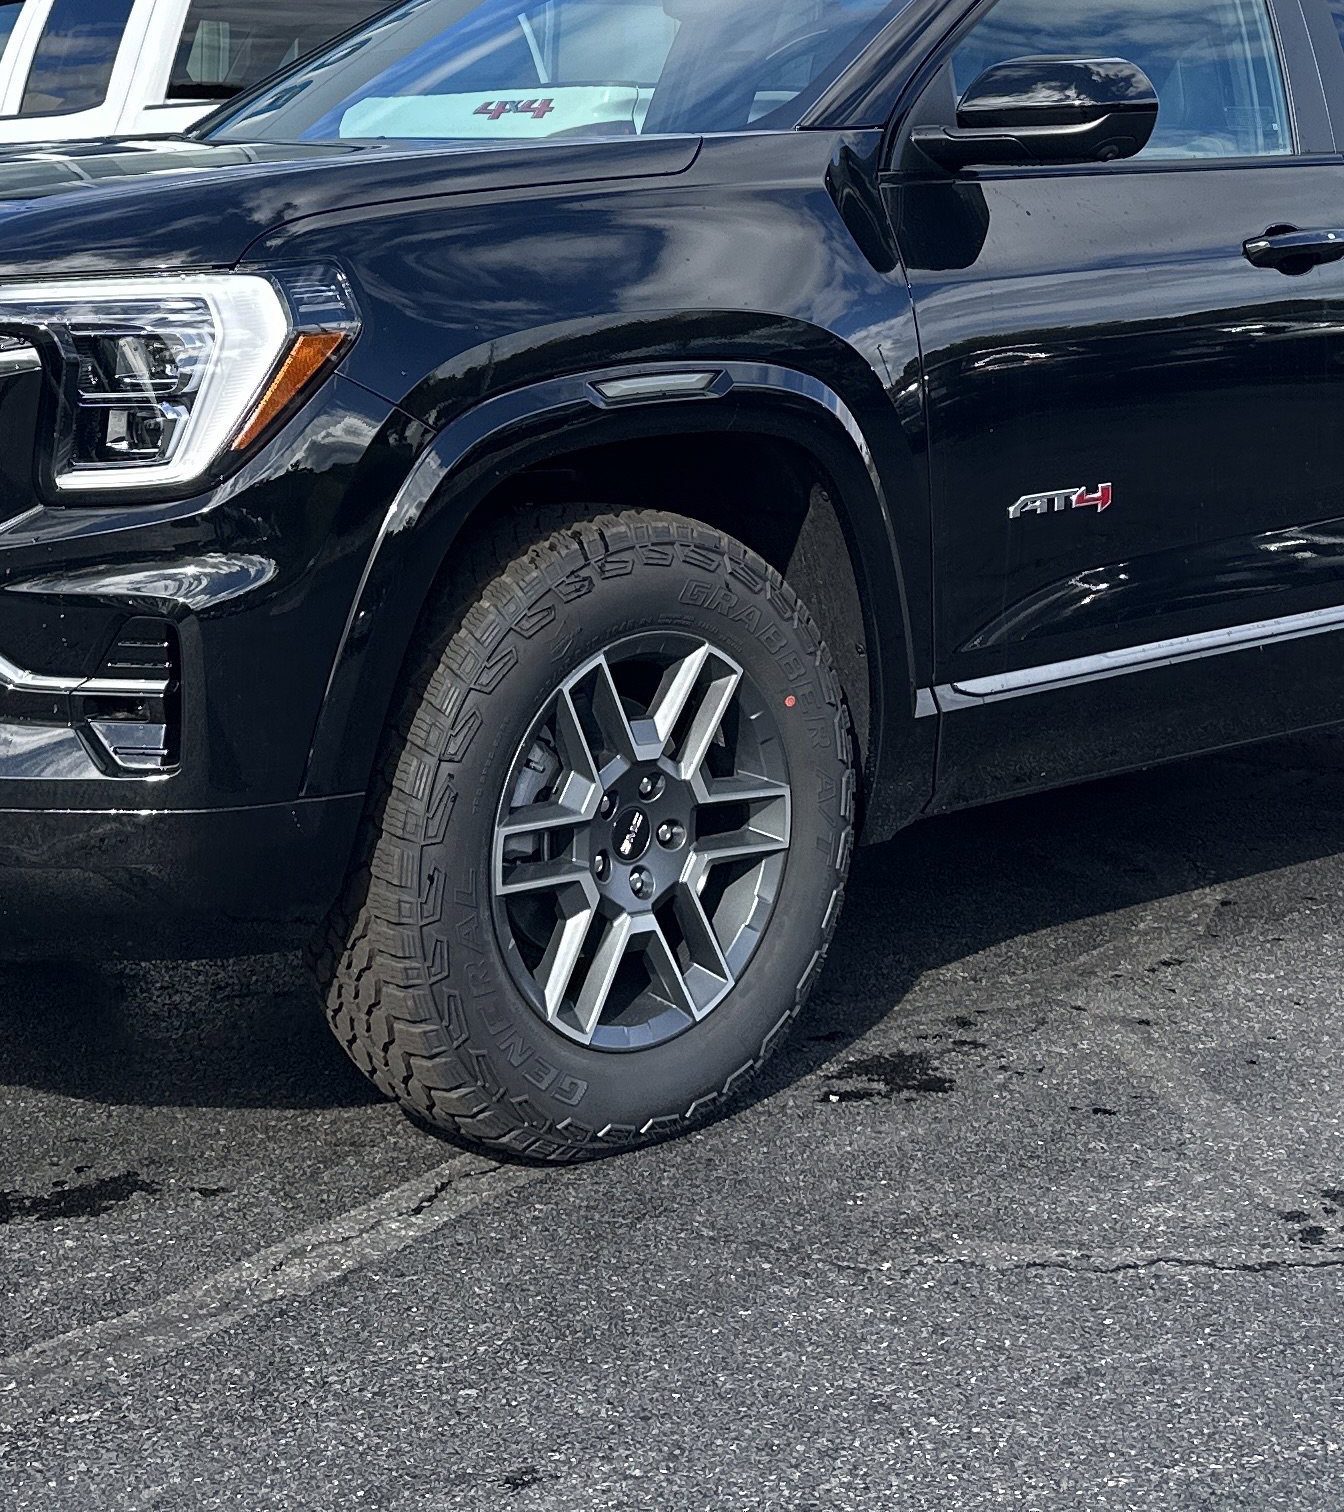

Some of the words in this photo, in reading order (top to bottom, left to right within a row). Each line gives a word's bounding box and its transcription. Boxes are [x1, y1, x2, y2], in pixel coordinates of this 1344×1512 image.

[1006, 482, 1112, 519] AT4
[678, 579, 832, 751] GRABBER
[453, 868, 589, 1106] GENERAL
